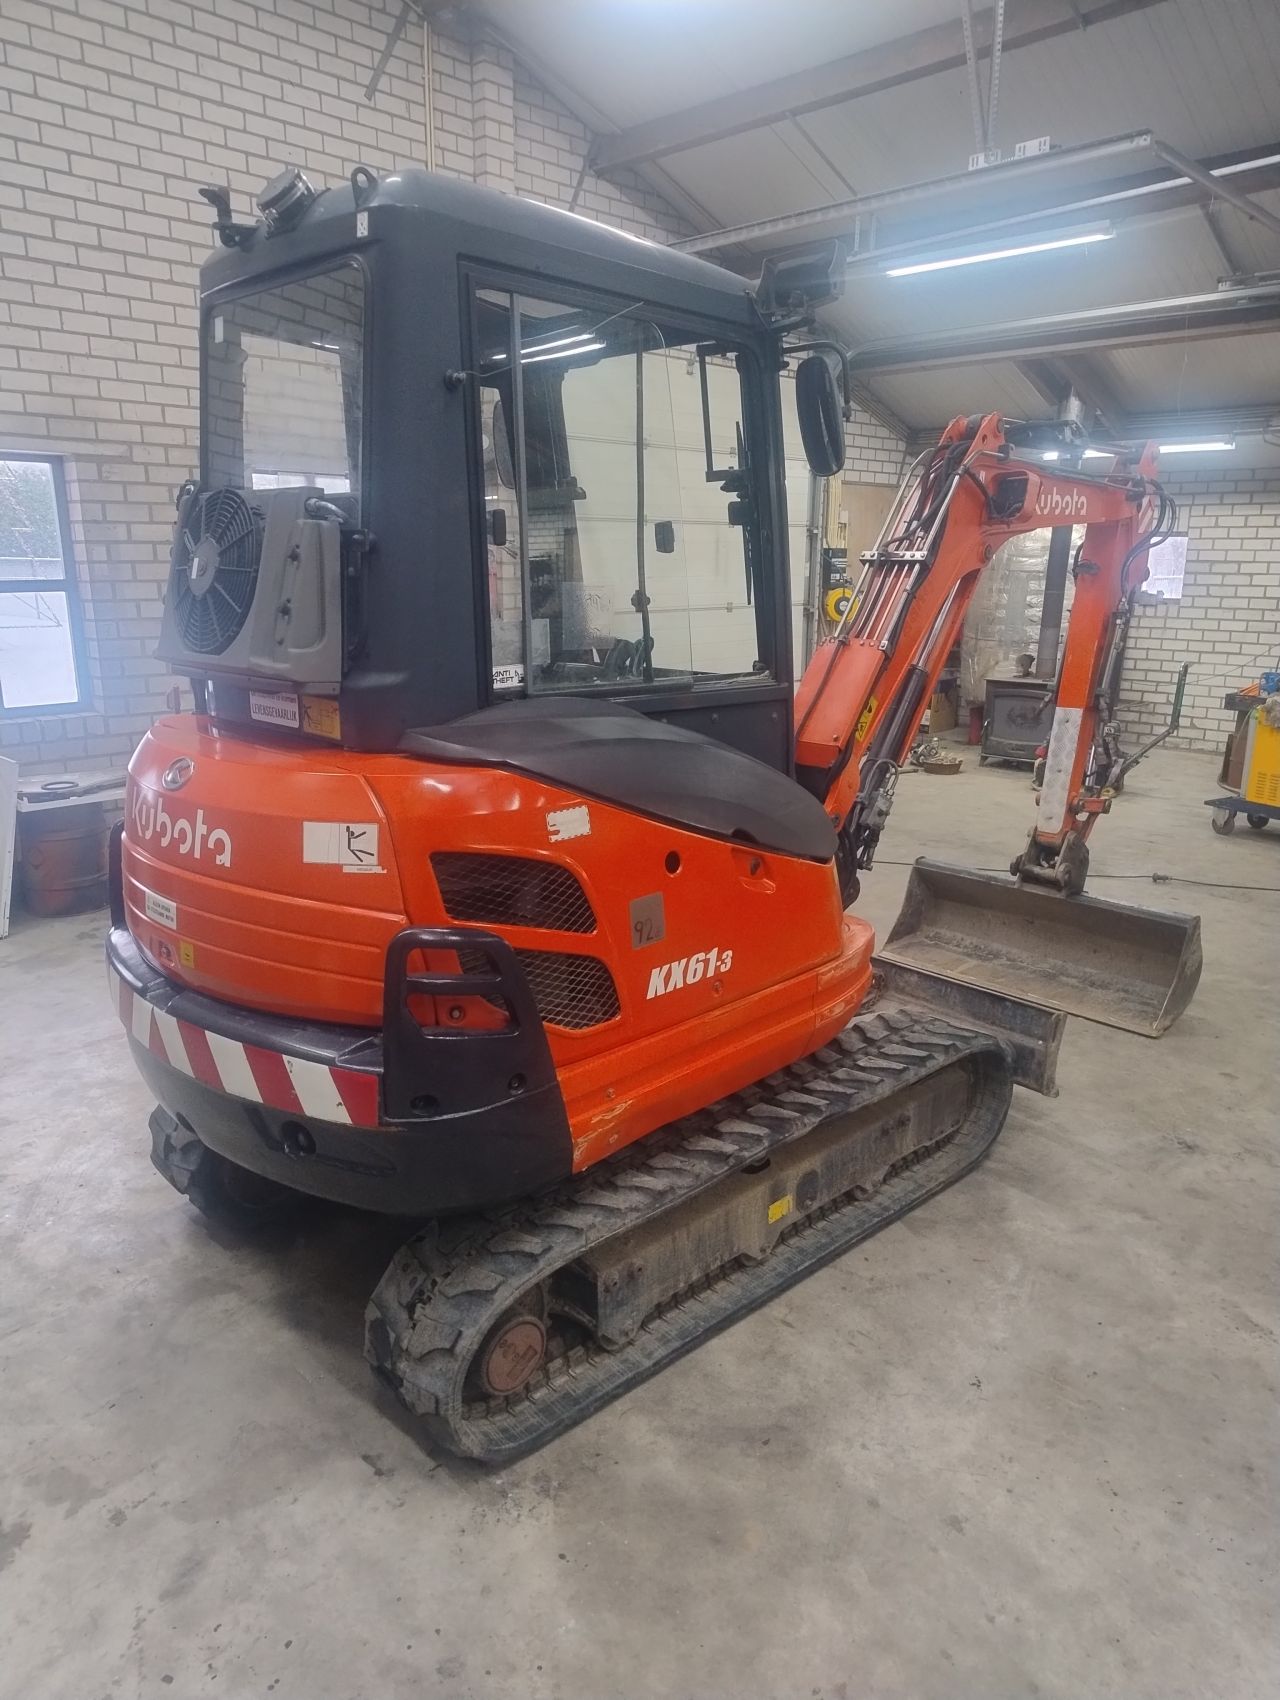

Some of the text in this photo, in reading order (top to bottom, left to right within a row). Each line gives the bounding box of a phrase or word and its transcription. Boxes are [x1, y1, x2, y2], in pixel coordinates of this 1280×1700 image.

[492, 670, 511, 678] ANTI
[132, 786, 232, 868] Kubota
[646, 947, 733, 1000] KX61-3
